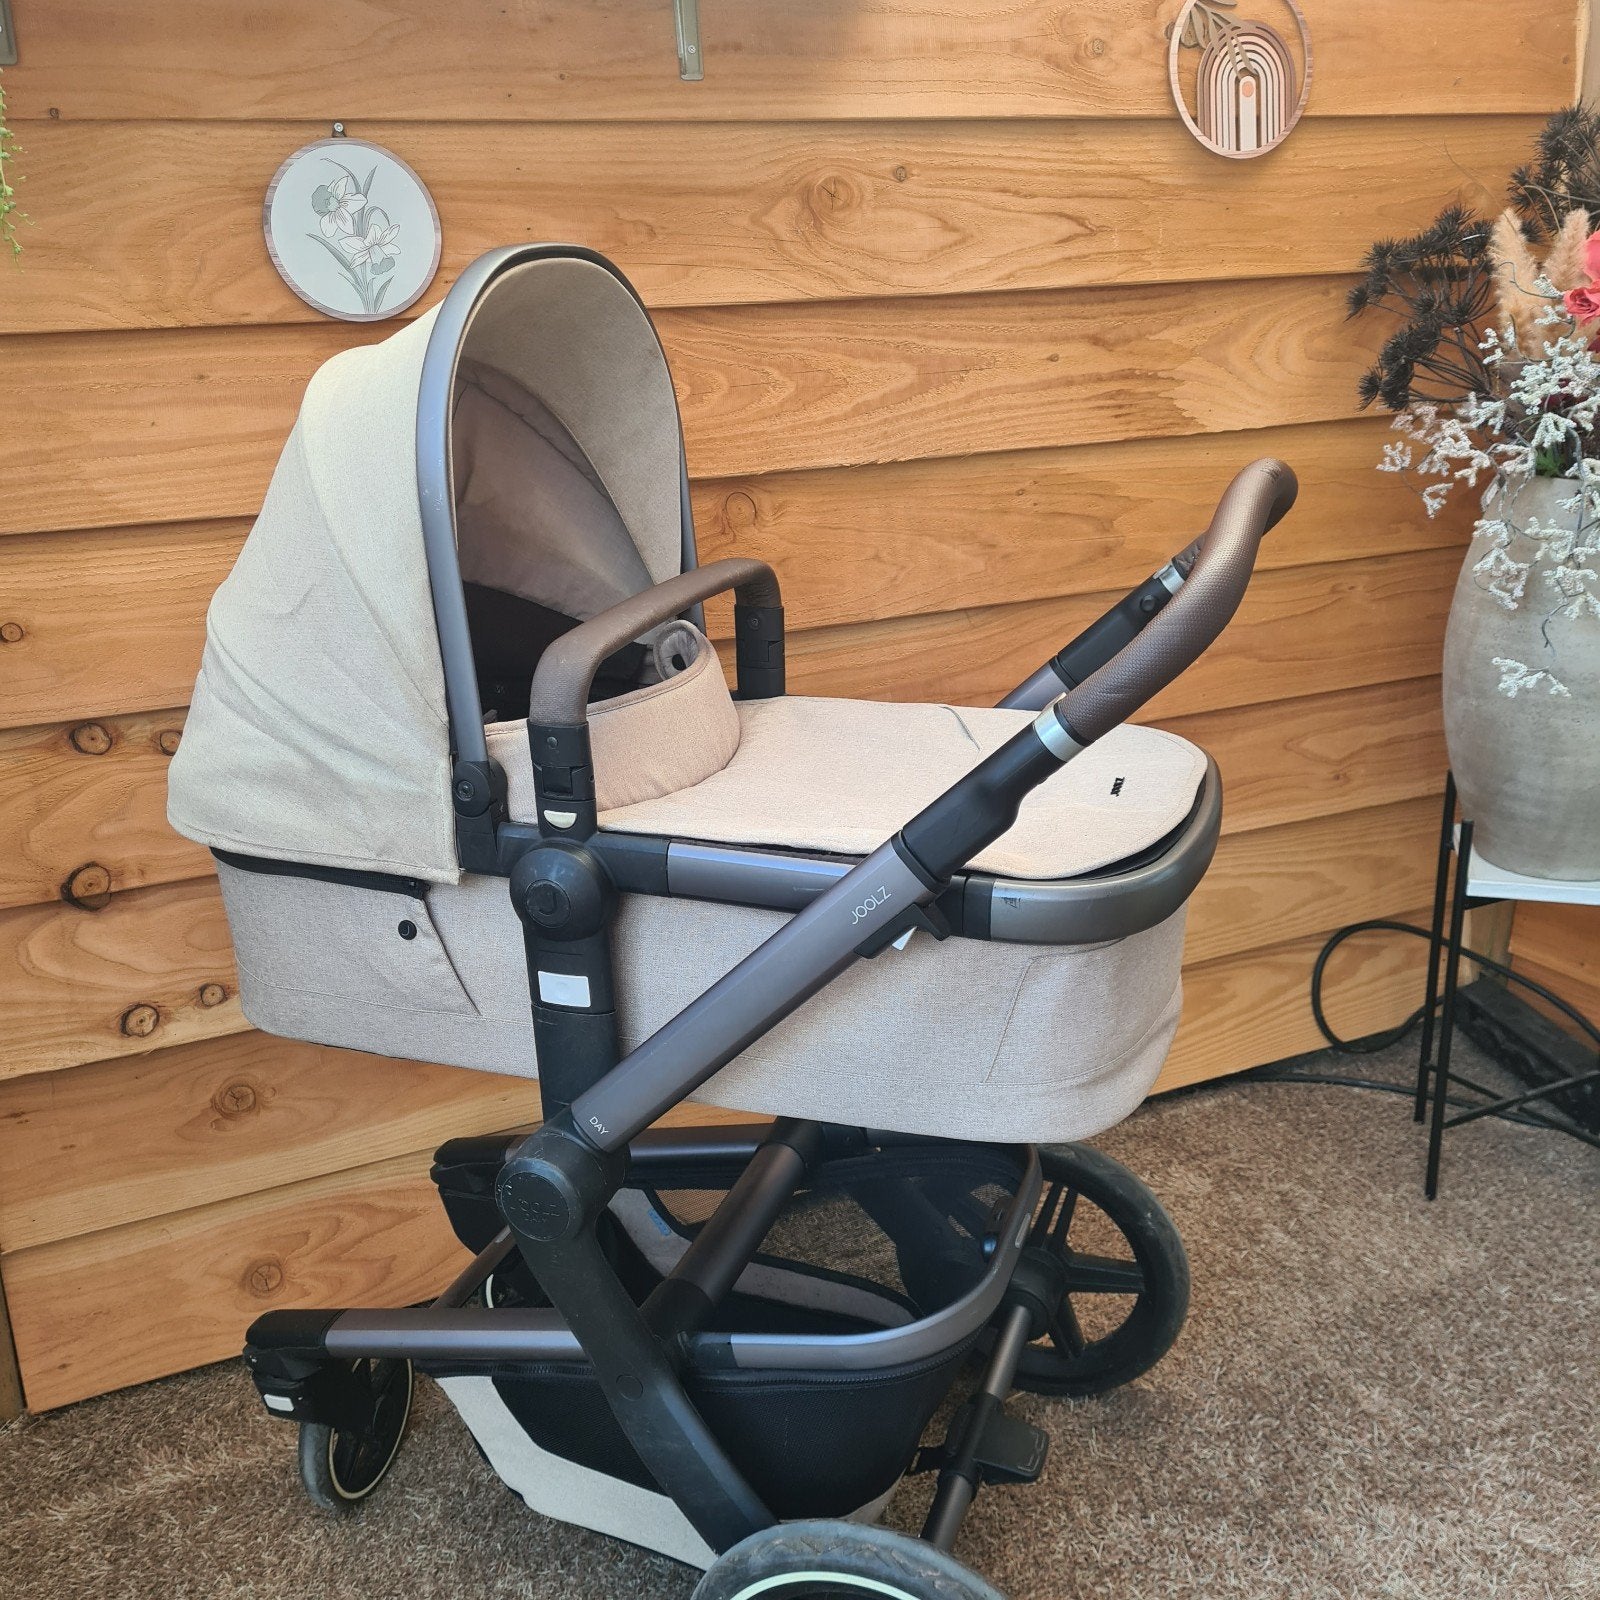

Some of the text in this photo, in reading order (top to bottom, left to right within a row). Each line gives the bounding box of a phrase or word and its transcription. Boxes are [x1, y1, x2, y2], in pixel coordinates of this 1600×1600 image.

[851, 885, 892, 925] JOOLZ
[401, 925, 410, 936] J
[590, 1116, 609, 1135] DAY
